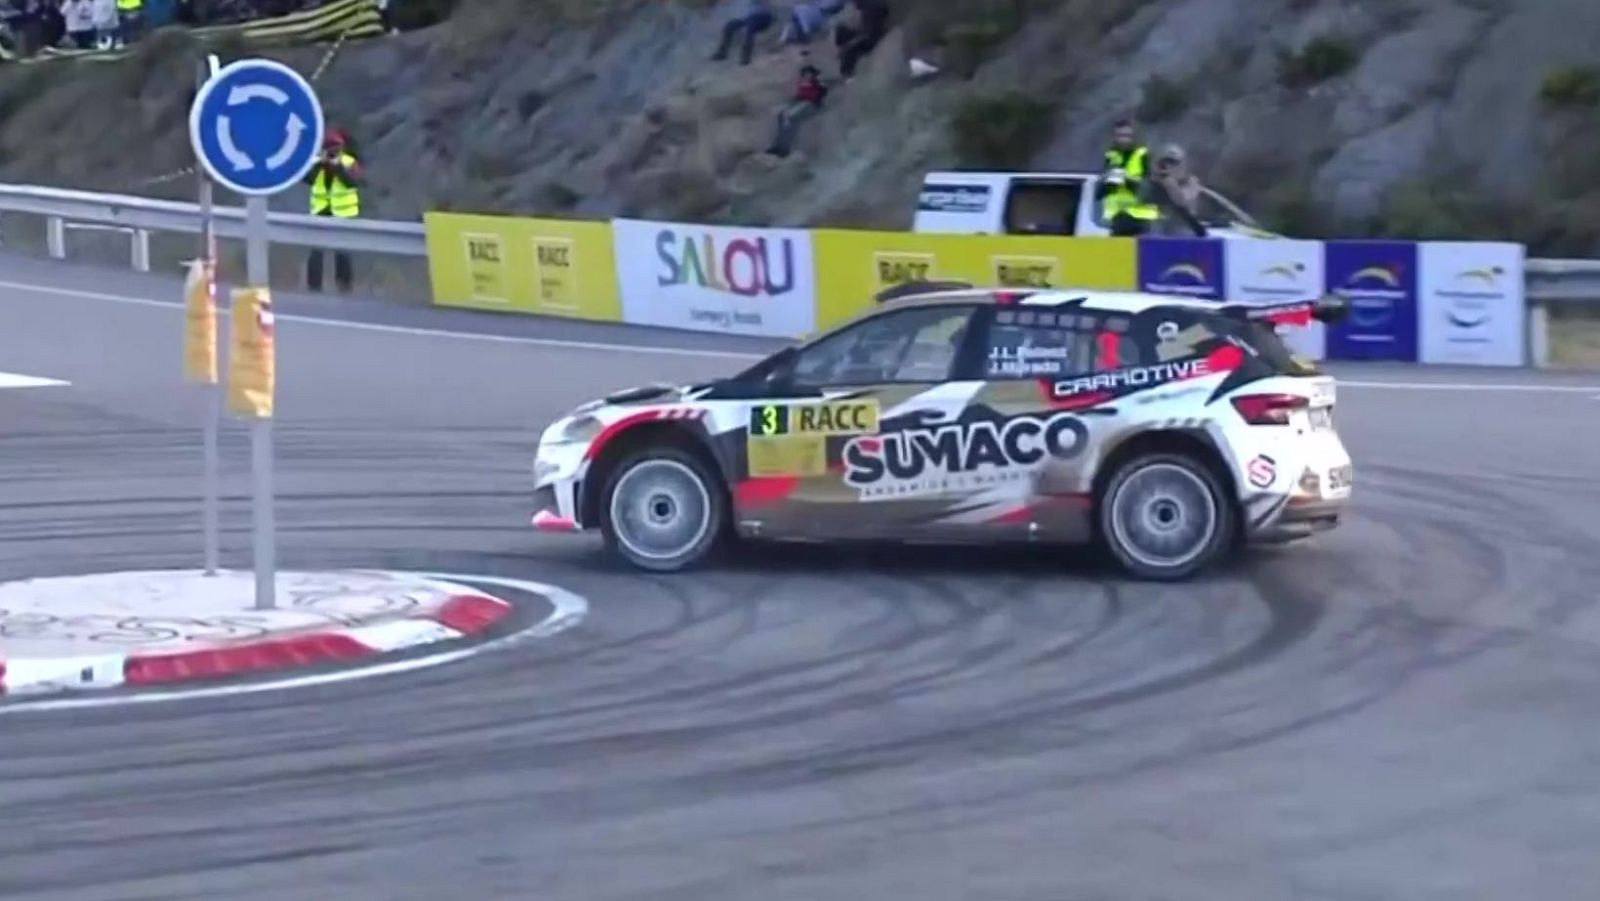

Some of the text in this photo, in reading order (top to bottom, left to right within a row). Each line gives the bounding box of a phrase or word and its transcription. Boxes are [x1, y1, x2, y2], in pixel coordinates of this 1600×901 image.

[469, 241, 500, 263] RACC
[537, 245, 570, 268] RACC
[656, 229, 794, 297] SALOU
[762, 406, 778, 434] 3
[800, 404, 867, 431] RACC
[846, 414, 1090, 484] SUMACO
